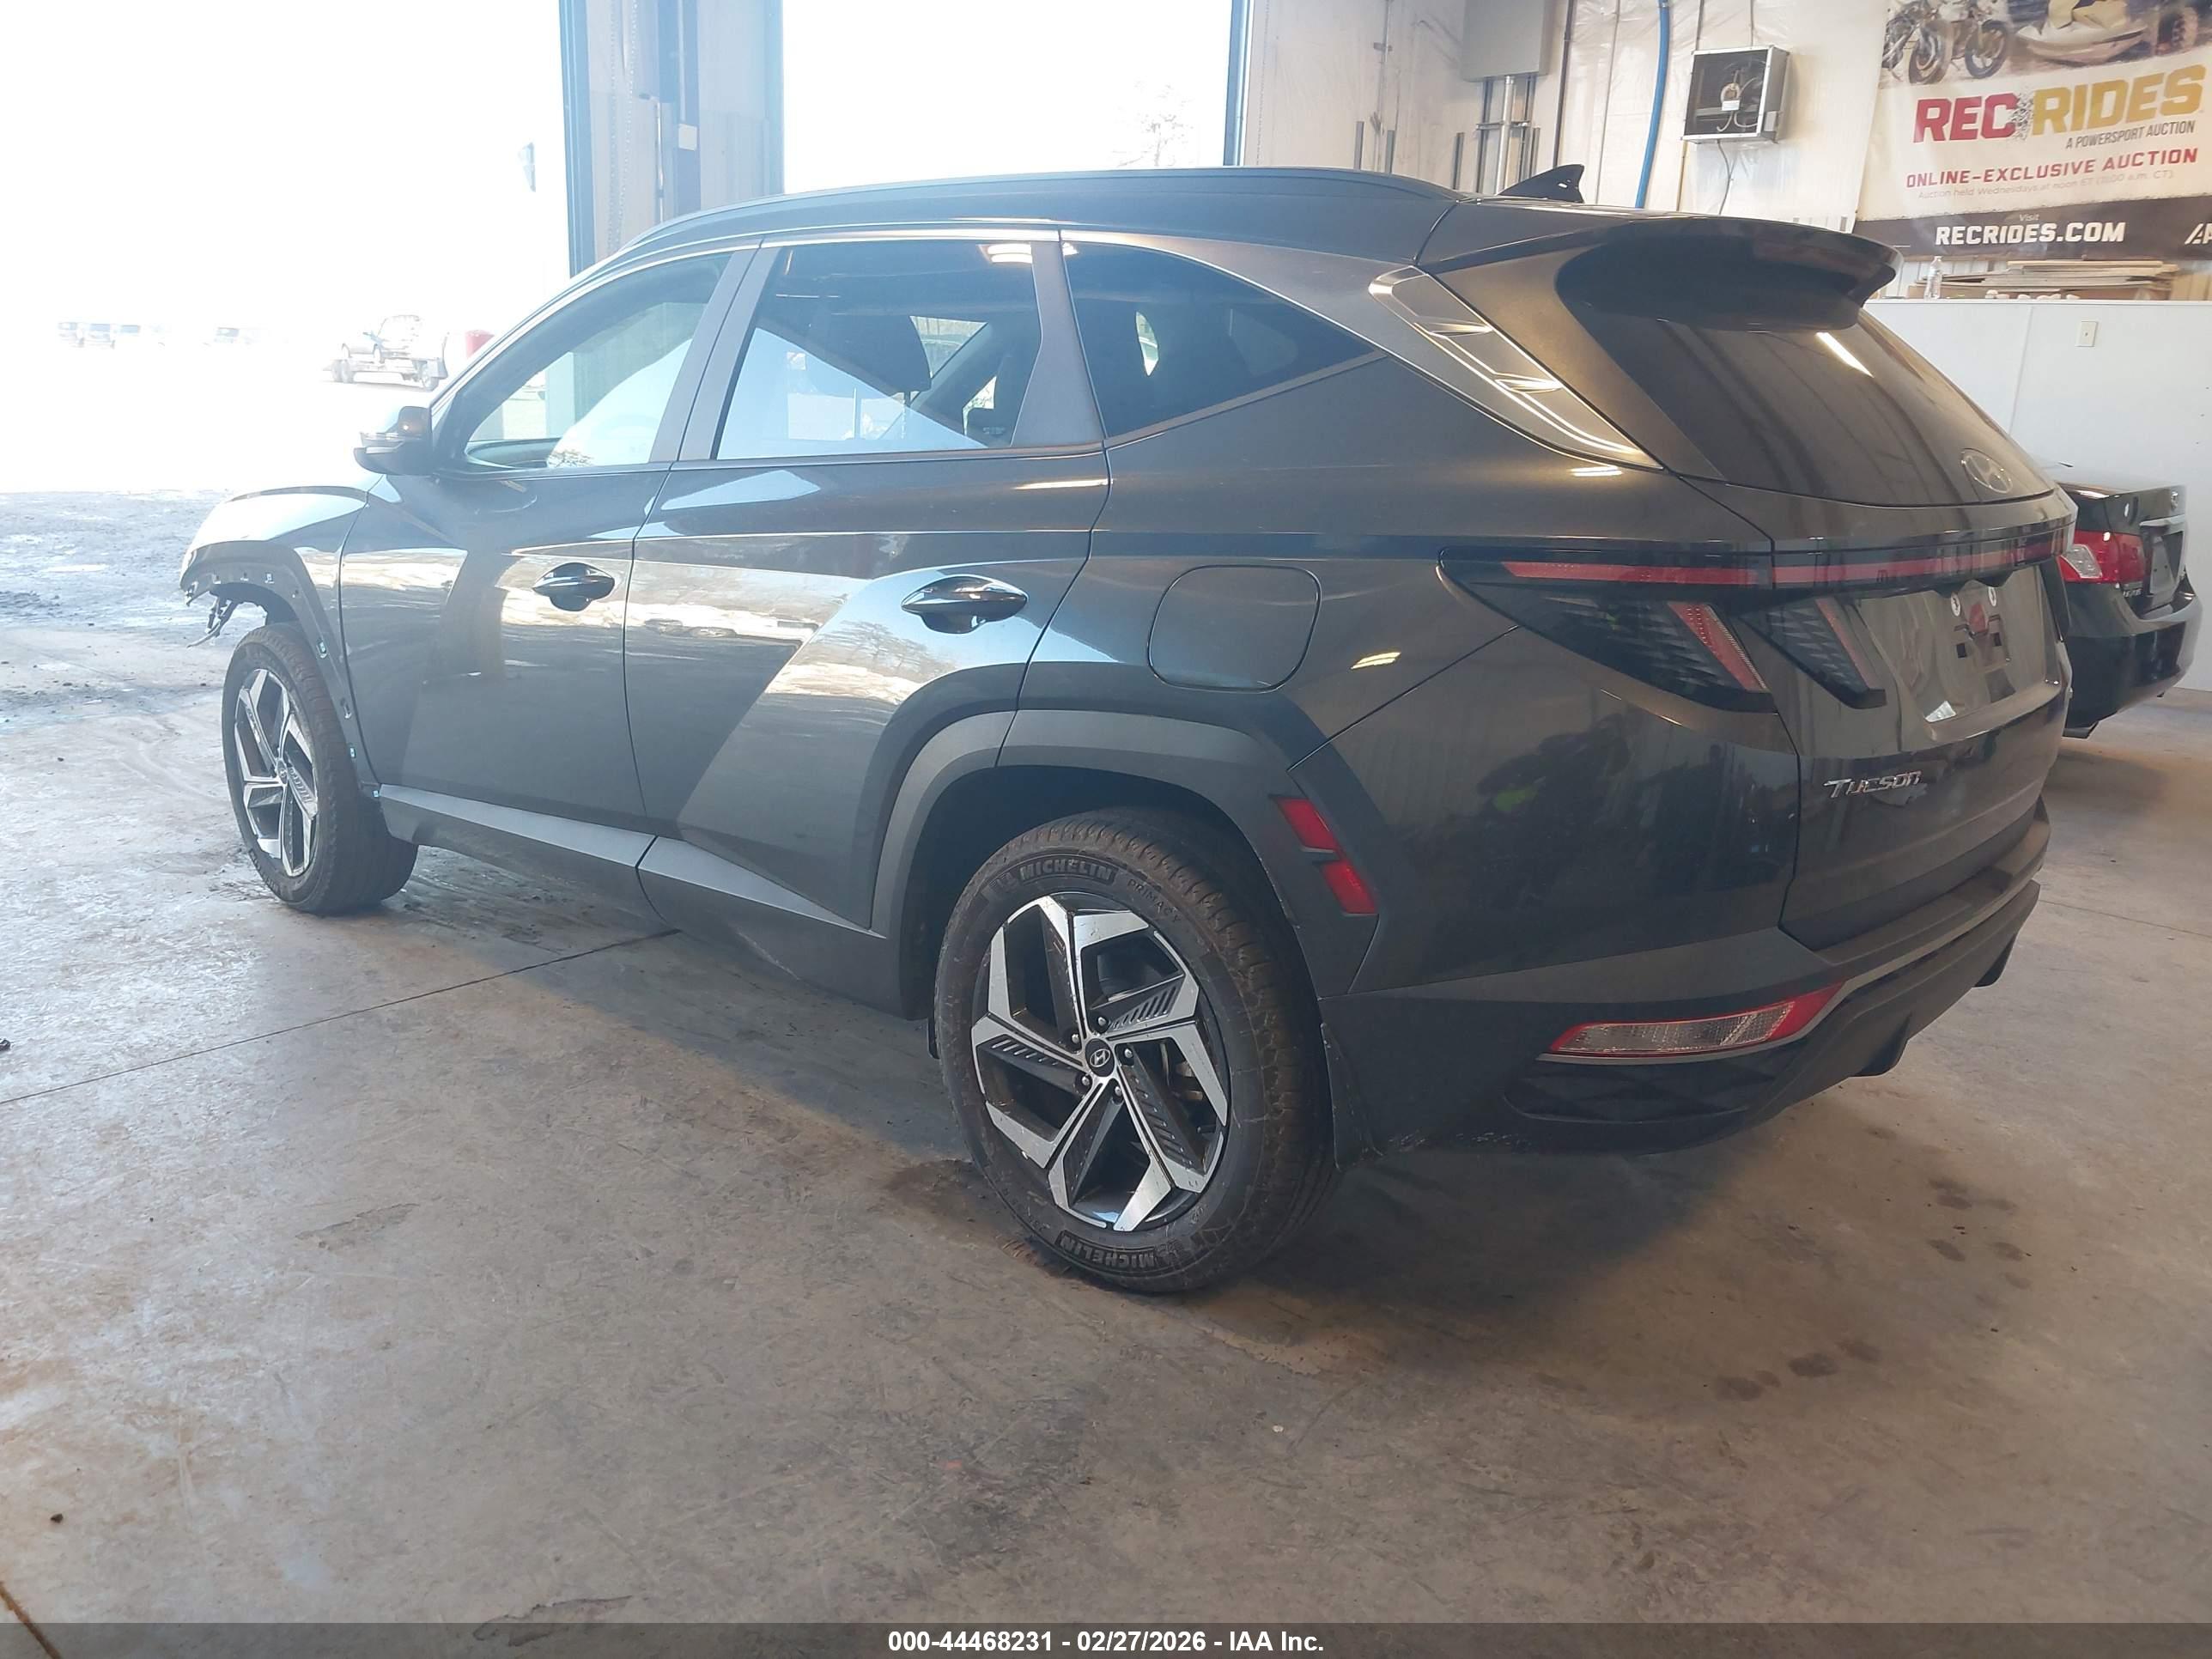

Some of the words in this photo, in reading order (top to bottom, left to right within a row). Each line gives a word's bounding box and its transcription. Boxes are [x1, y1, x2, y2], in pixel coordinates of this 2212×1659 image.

[1913, 93, 2019, 143] REC
[2032, 64, 2207, 137] RIDES
[2065, 137, 2074, 149] A
[2075, 126, 2145, 149] POWERSPORT
[2146, 120, 2196, 137] AUCTION
[1906, 159, 2096, 188] ONLINE-EXCLUSIVE
[2101, 148, 2198, 172] AUCTION
[2020, 214, 2039, 222] Visit
[1935, 222, 2126, 246] RECRIDES.COM
[1019, 858, 1113, 882] MICHELIN
[1127, 878, 1182, 923] PRIMACY
[1060, 1235, 1155, 1268] MICHELIN
